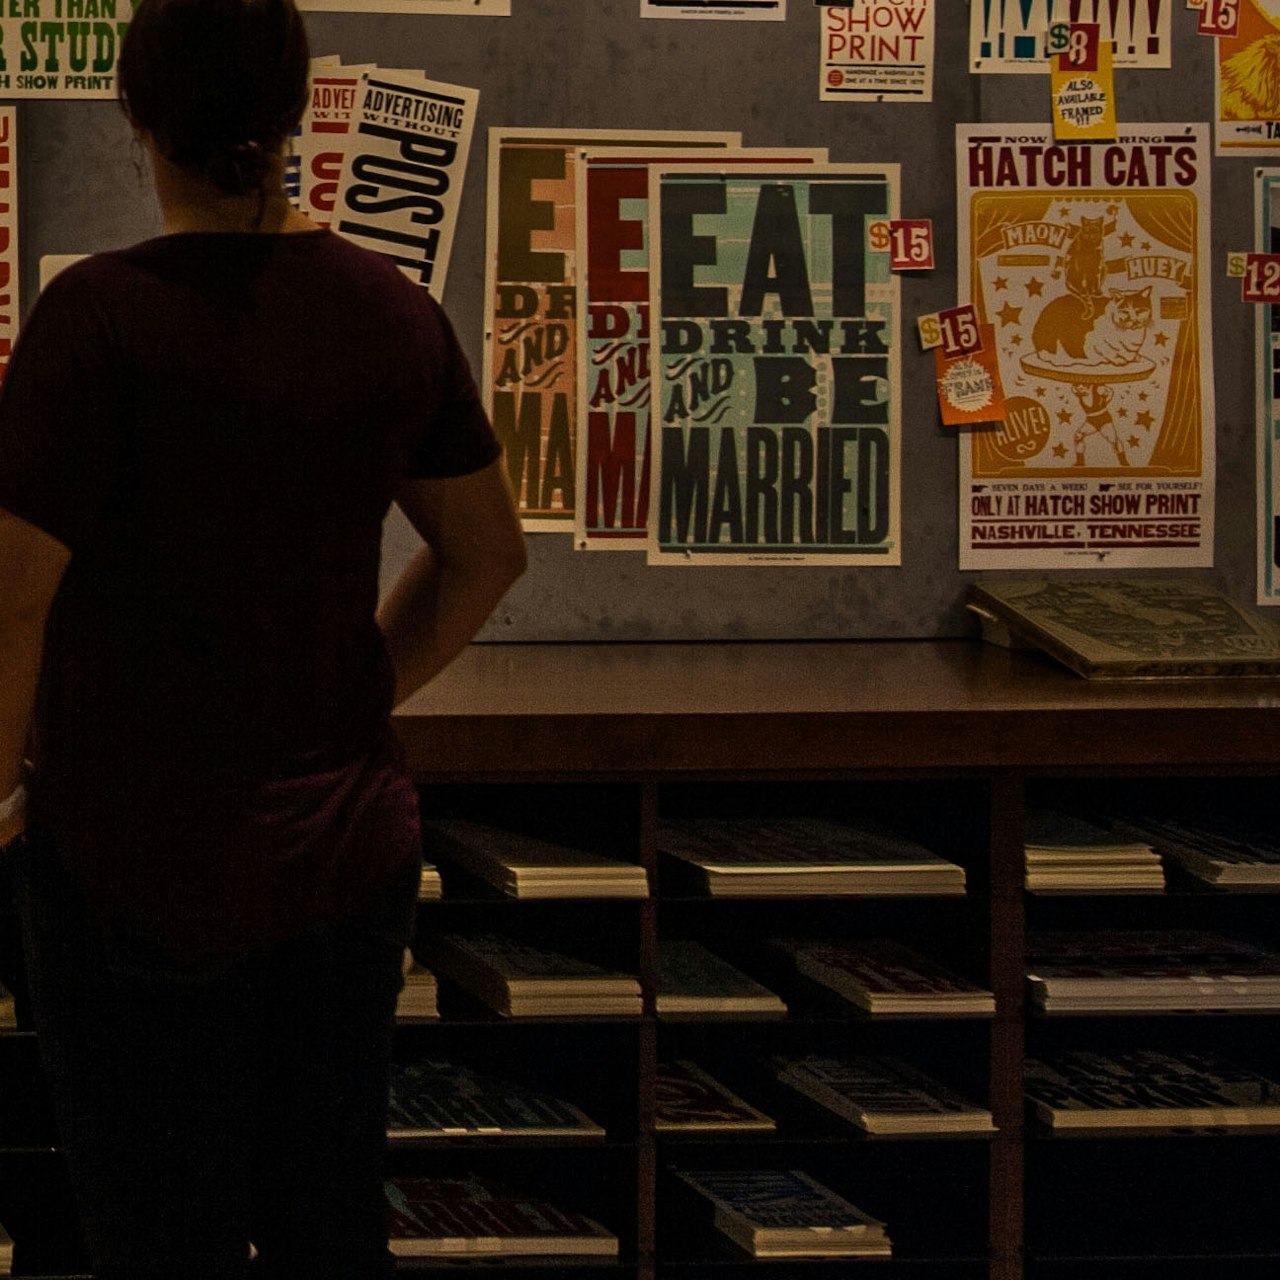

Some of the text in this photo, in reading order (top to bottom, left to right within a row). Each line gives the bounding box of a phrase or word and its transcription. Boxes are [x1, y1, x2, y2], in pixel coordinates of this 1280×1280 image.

[1058, 93, 1105, 105] AVAILABLE
[1067, 80, 1093, 91] ALSO
[362, 89, 464, 129] ADVERTISING
[363, 112, 460, 138] WITHOUT
[969, 146, 1197, 188] HATCH CATS
[661, 183, 887, 318] EAT
[1006, 224, 1064, 246] MAOW
[661, 320, 888, 355] DRINK
[753, 356, 888, 424] BE
[659, 427, 889, 547] MARRIED
